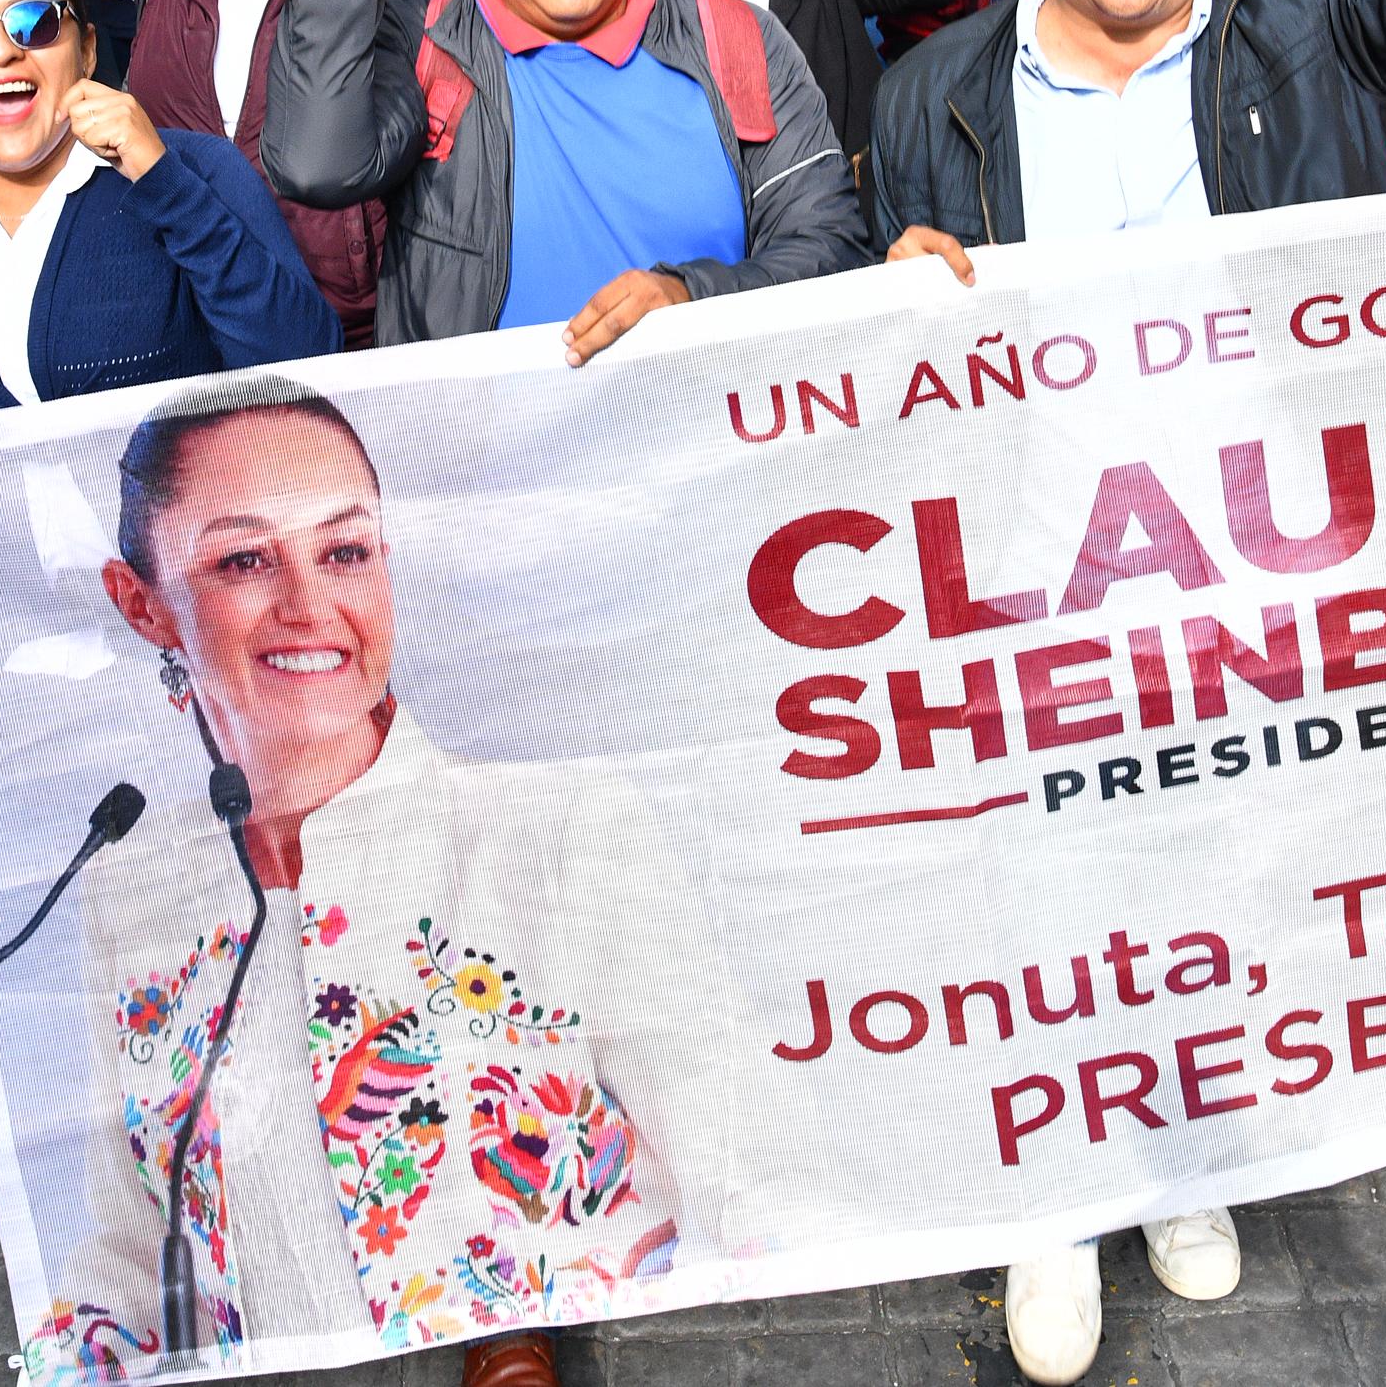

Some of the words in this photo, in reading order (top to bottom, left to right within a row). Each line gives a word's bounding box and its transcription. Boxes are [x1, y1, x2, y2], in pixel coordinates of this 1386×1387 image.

[726, 374, 860, 443] UN
[897, 330, 1098, 420] AÑO
[1133, 308, 1256, 377] DE
[771, 925, 1269, 1063] Jonuta,
